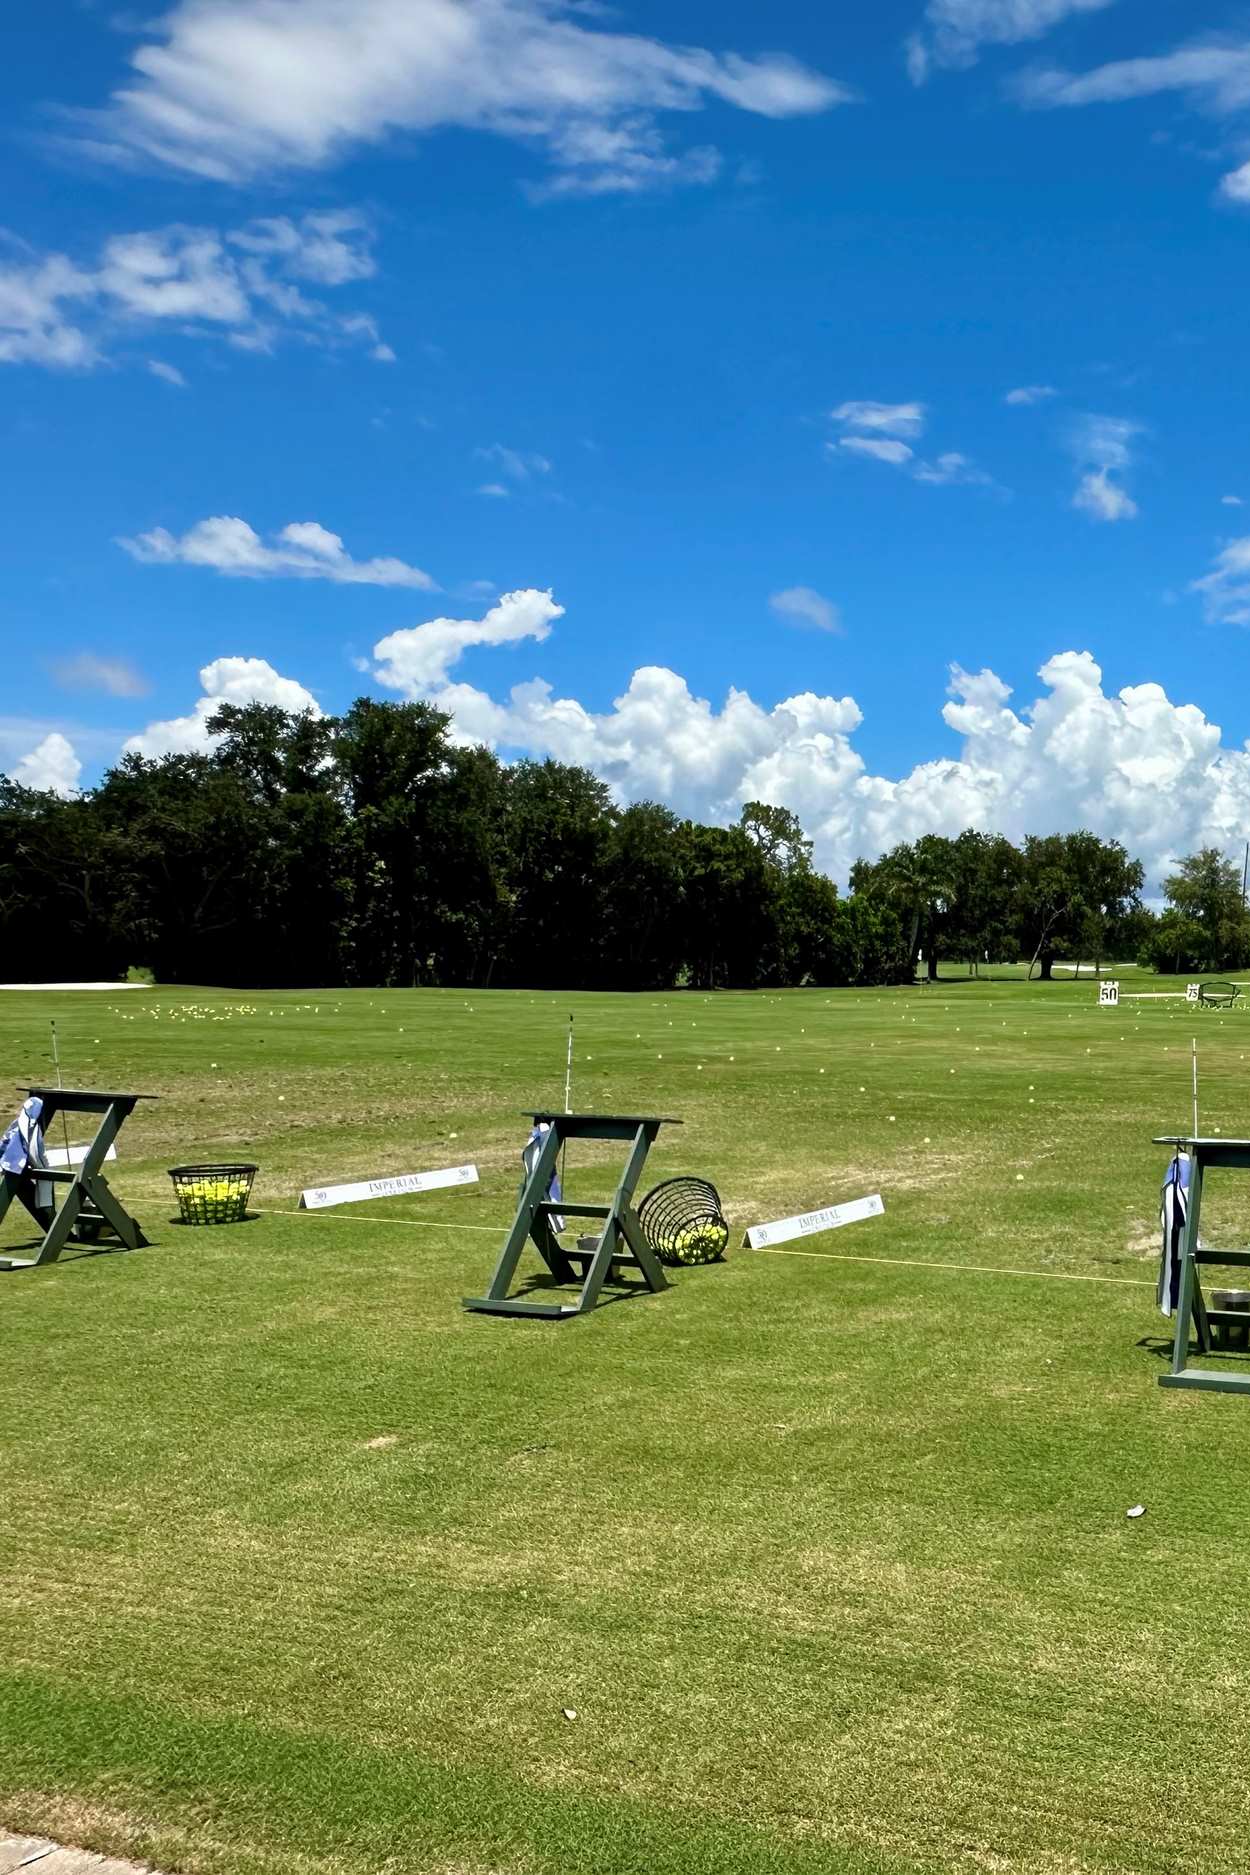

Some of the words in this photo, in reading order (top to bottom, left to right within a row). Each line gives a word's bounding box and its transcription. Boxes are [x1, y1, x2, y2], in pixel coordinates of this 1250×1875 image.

[1101, 987, 1117, 1001] 50
[1188, 988, 1198, 998] 75
[368, 1176, 422, 1193] IMPERIAL
